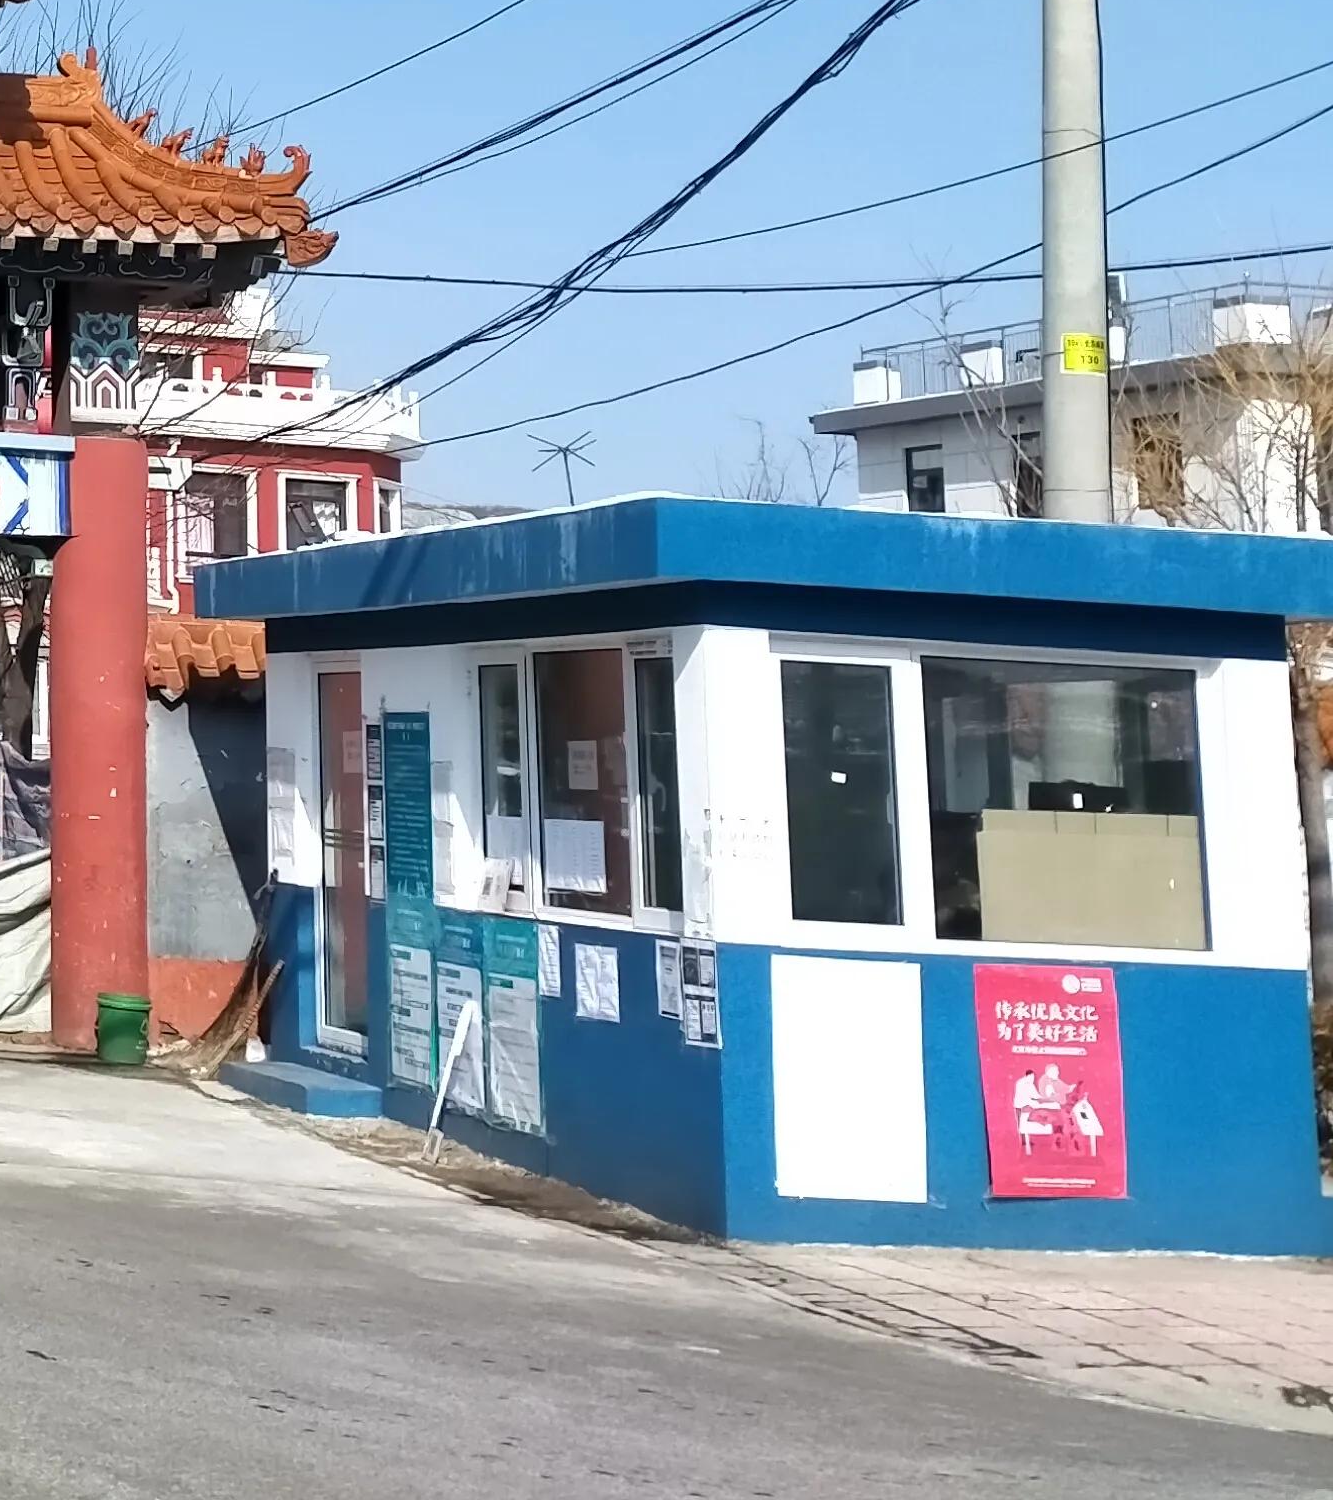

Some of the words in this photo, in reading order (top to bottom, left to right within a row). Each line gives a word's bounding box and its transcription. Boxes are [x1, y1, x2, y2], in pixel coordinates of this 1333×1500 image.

[995, 1000, 1099, 1022] 传承优良文化
[997, 1021, 1098, 1043] 为了美好生活
